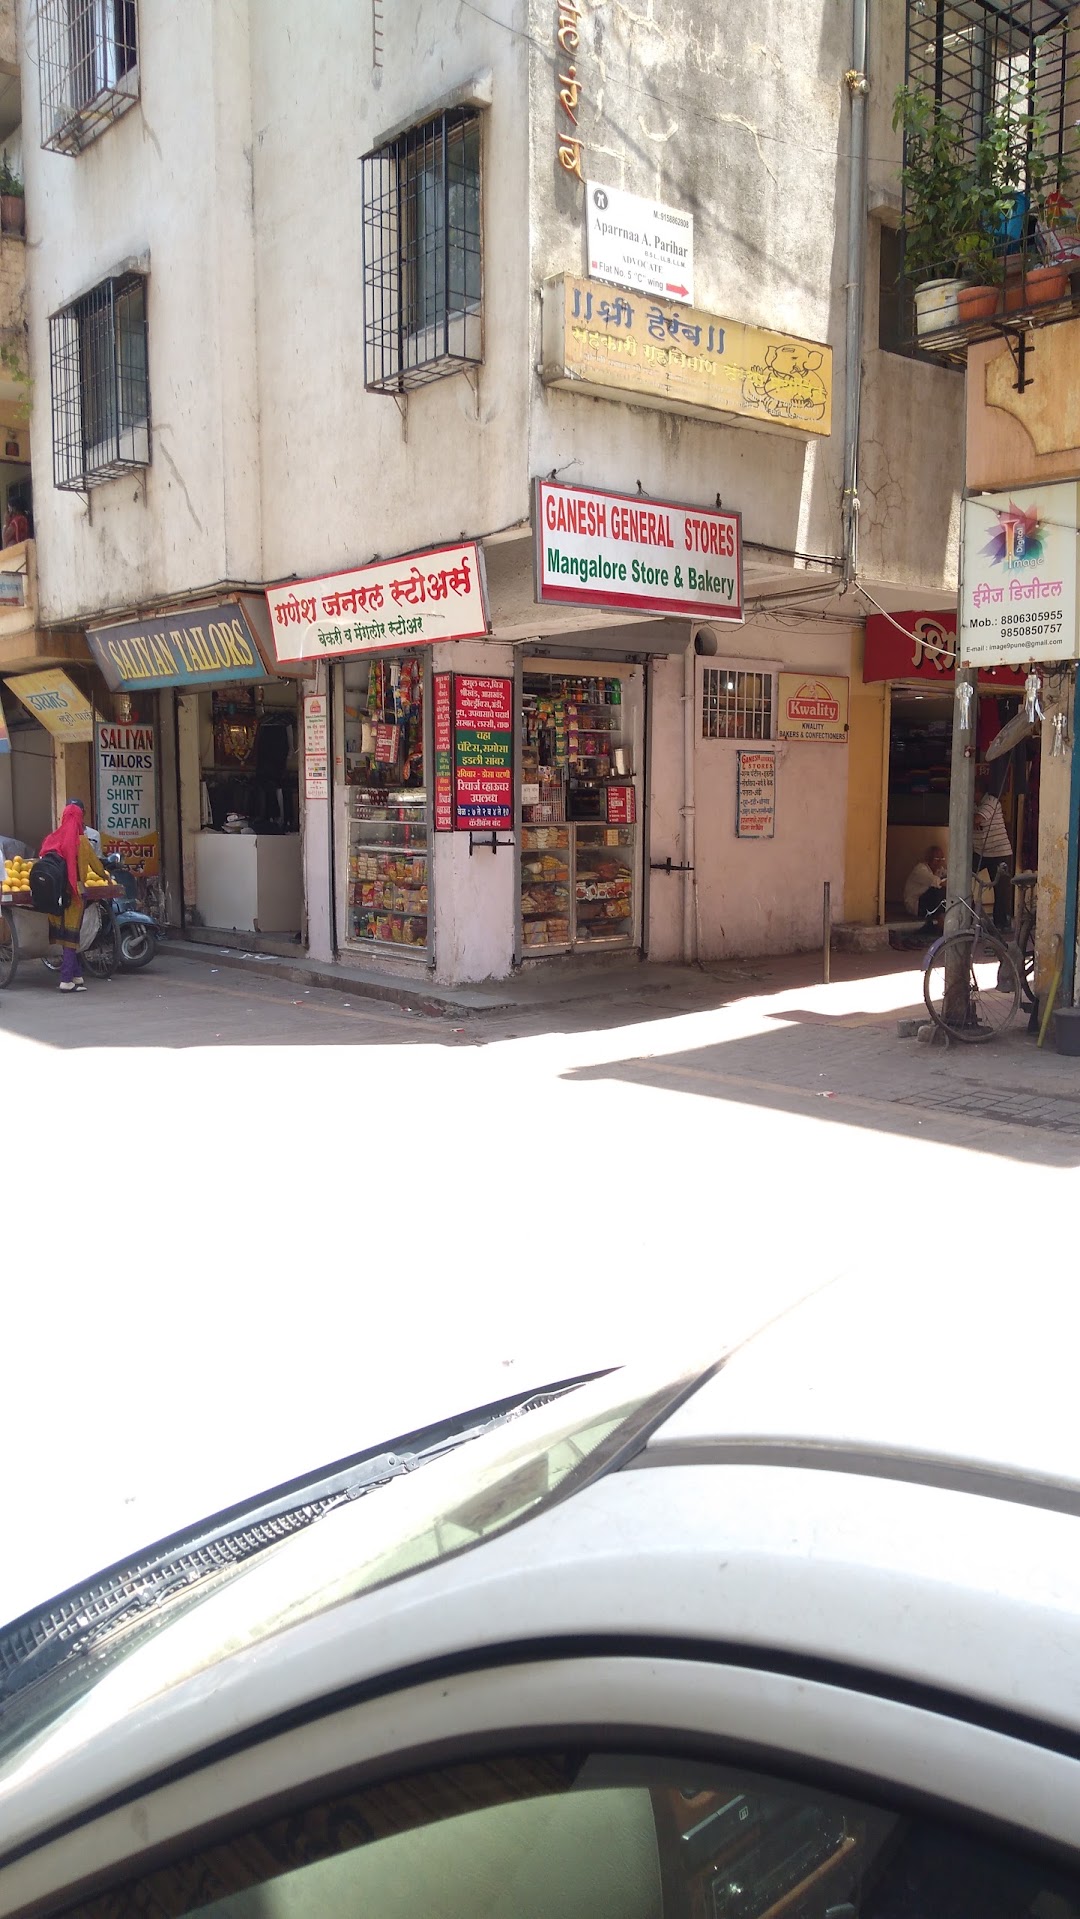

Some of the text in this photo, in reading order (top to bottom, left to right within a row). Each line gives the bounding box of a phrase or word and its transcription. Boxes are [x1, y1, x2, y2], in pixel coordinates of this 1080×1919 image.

[594, 218, 689, 258] Aparrnaa A. Parihar
[622, 255, 663, 274] ADVOCATE
[599, 261, 612, 274] Flat
[614, 266, 626, 278] No.
[627, 270, 632, 280] 5
[647, 278, 664, 291] wing
[546, 494, 734, 557] GANESH GENERAL STORES
[1016, 527, 1024, 553] Digital
[547, 547, 735, 600] Mangalore Store & Bakery
[274, 556, 471, 627] गणेश जनरल स्टोअर्स
[972, 576, 1063, 608] ईमेज डिजीटल
[1000, 610, 1063, 625] 8806305955
[317, 628, 343, 647] बेकरी
[344, 628, 353, 644] व
[388, 615, 424, 637] स्टोअर
[1000, 623, 1063, 638] 9850850757
[108, 619, 254, 680] SALIYAN TAILORS
[966, 645, 984, 653] E-mail
[989, 638, 1063, 652] image9pune@gmail.com
[790, 701, 836, 719] Kwality
[100, 728, 153, 750] SALIYAN
[806, 732, 846, 740] CONFECTIONERS
[100, 753, 152, 769] TAILORS
[462, 754, 505, 765] इडली सांबर
[741, 755, 760, 764] GANESH
[112, 774, 143, 787] PANT
[457, 769, 476, 778] रविवार
[482, 769, 494, 778] डोसा
[457, 779, 480, 791] रिचार्ज
[106, 788, 143, 801] SHIRT
[470, 793, 498, 803] उपलब्ध
[111, 802, 140, 815] SUIT
[107, 817, 151, 829] SAFARI
